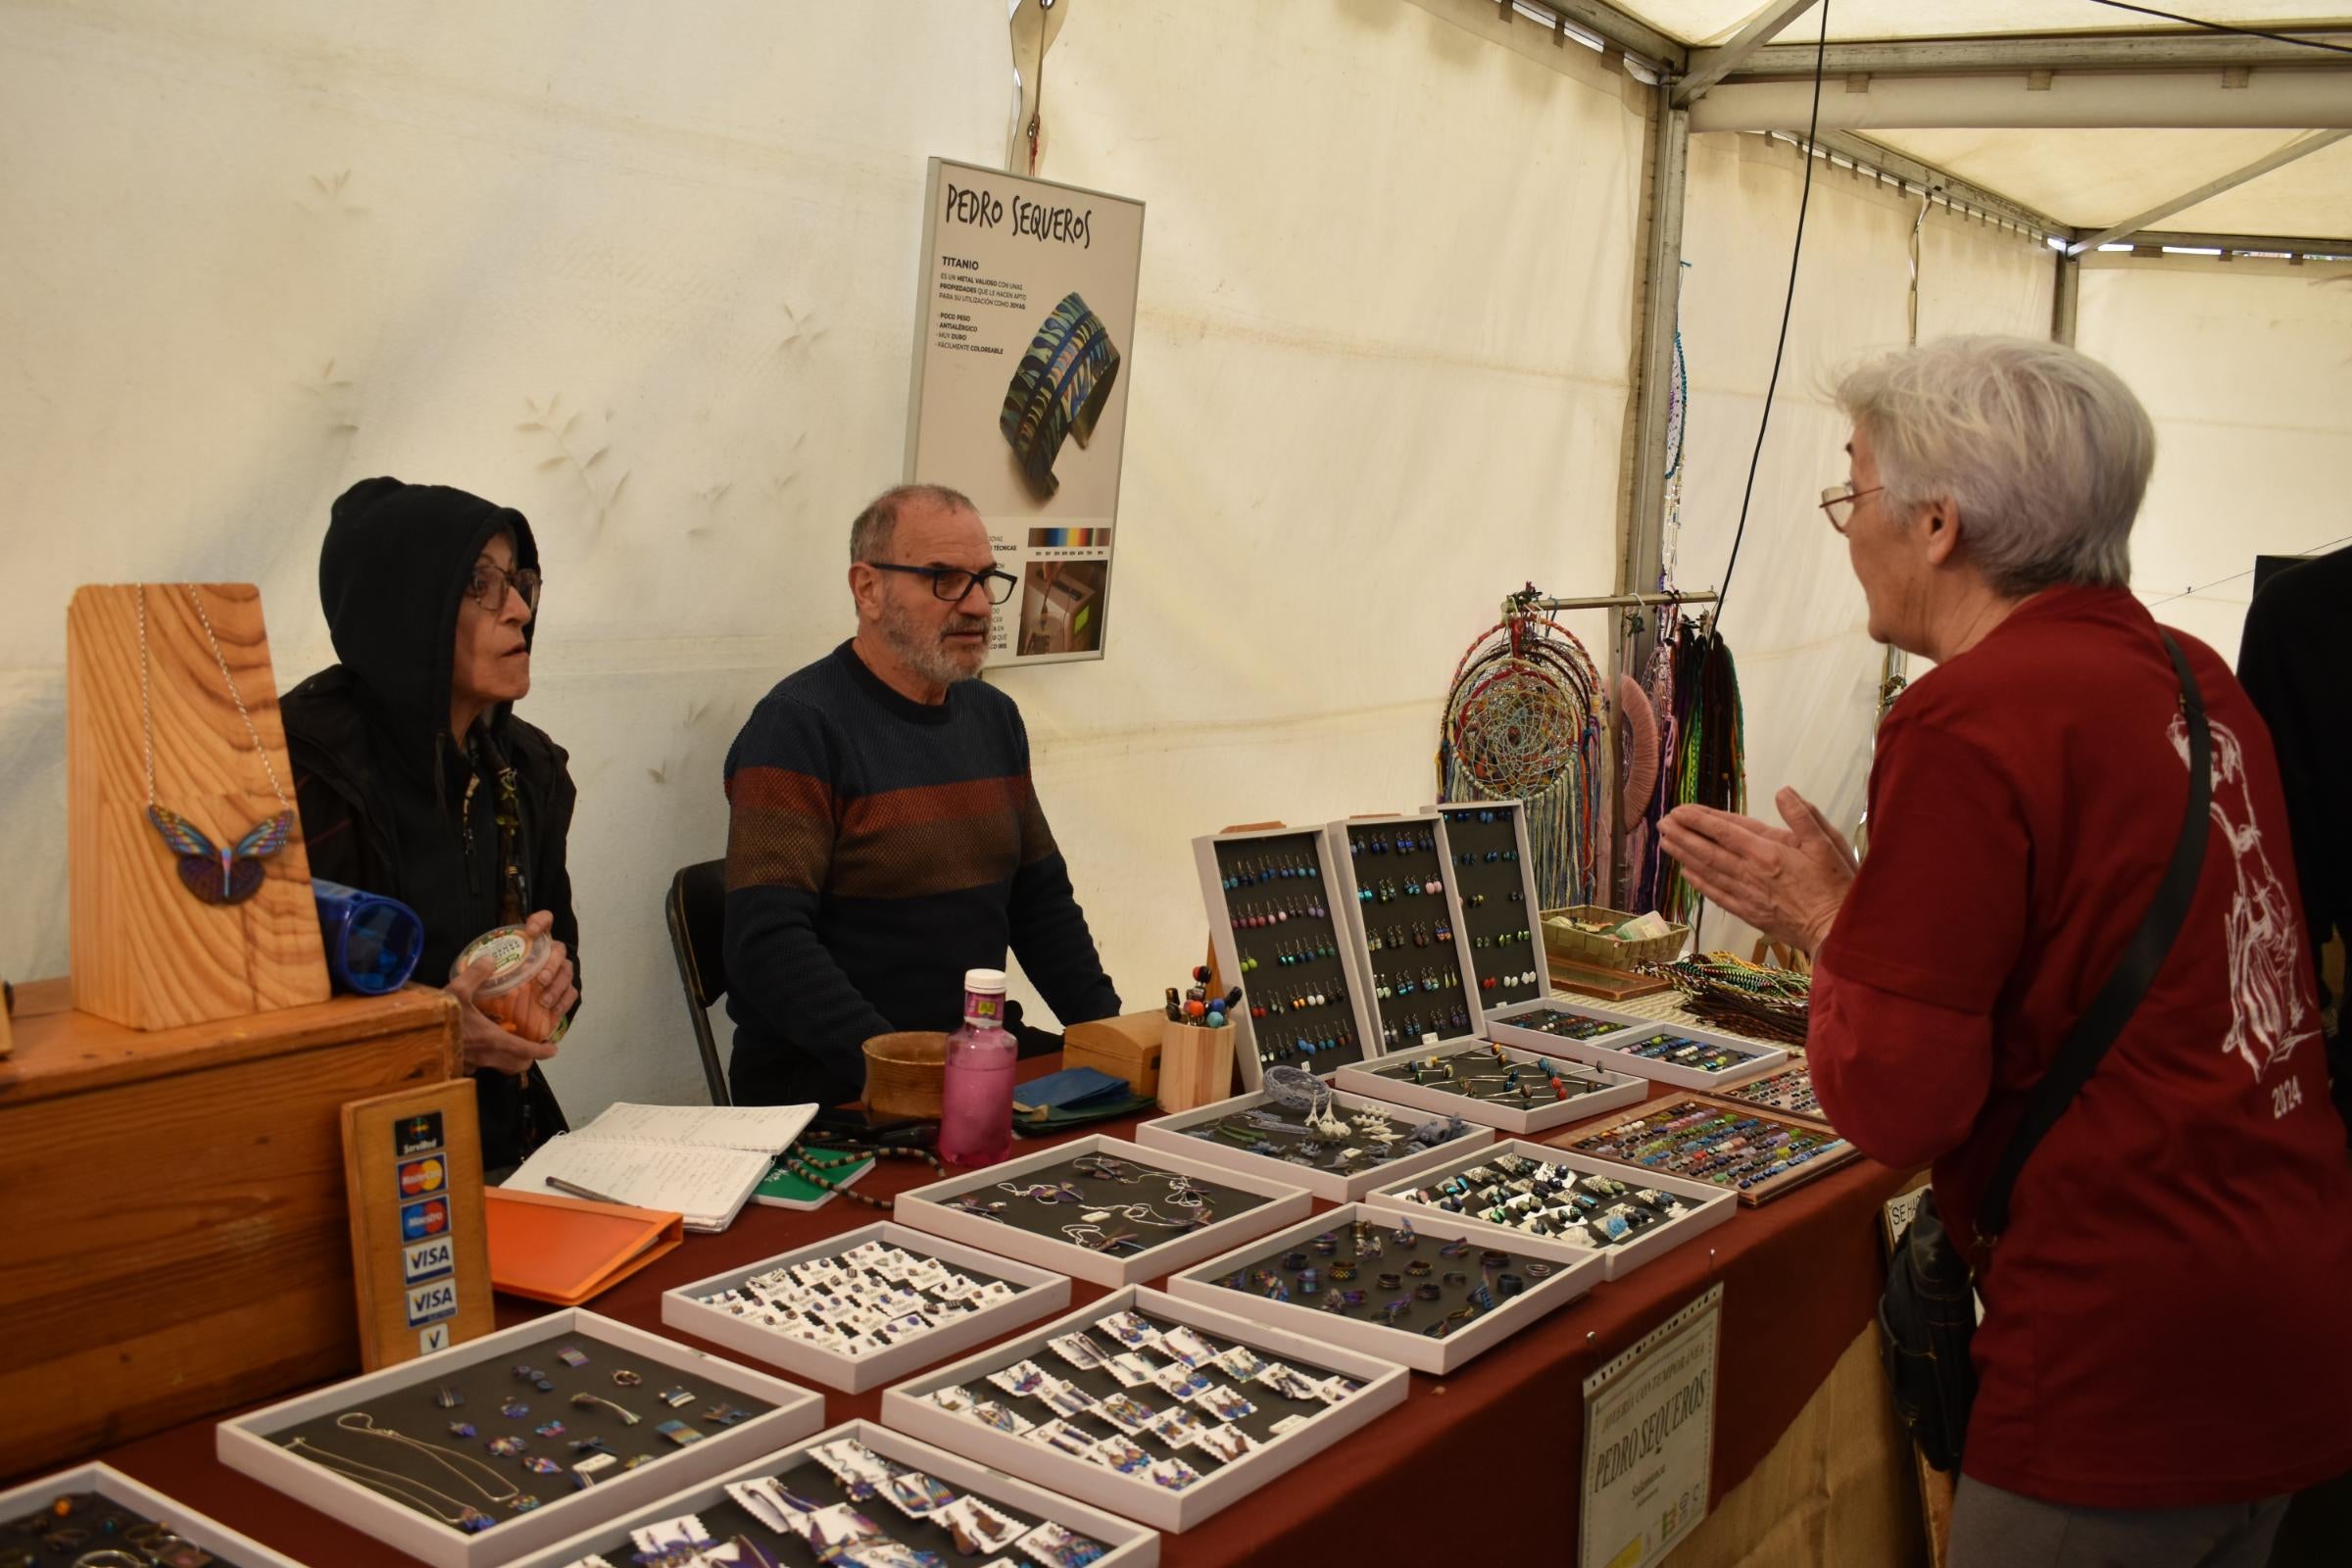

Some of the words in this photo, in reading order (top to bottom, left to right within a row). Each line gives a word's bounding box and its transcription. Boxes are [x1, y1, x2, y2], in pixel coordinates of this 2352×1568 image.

[946, 183, 1004, 228] PEDRO
[1012, 195, 1092, 249] SEQUEROS
[942, 256, 979, 270] TITANIO
[940, 282, 977, 293] PROPIEDADES
[997, 290, 1013, 299] HACEN
[970, 345, 1004, 355] COLOREABLE
[2272, 1075, 2302, 1119] 2024
[408, 1211, 444, 1227] Maestro
[1891, 1203, 1906, 1225] SE
[409, 1245, 450, 1269] VISA
[414, 1287, 453, 1312] VISA
[1594, 1427, 1639, 1494] PEDRO
[1639, 1368, 1707, 1459] SEQUEROS
